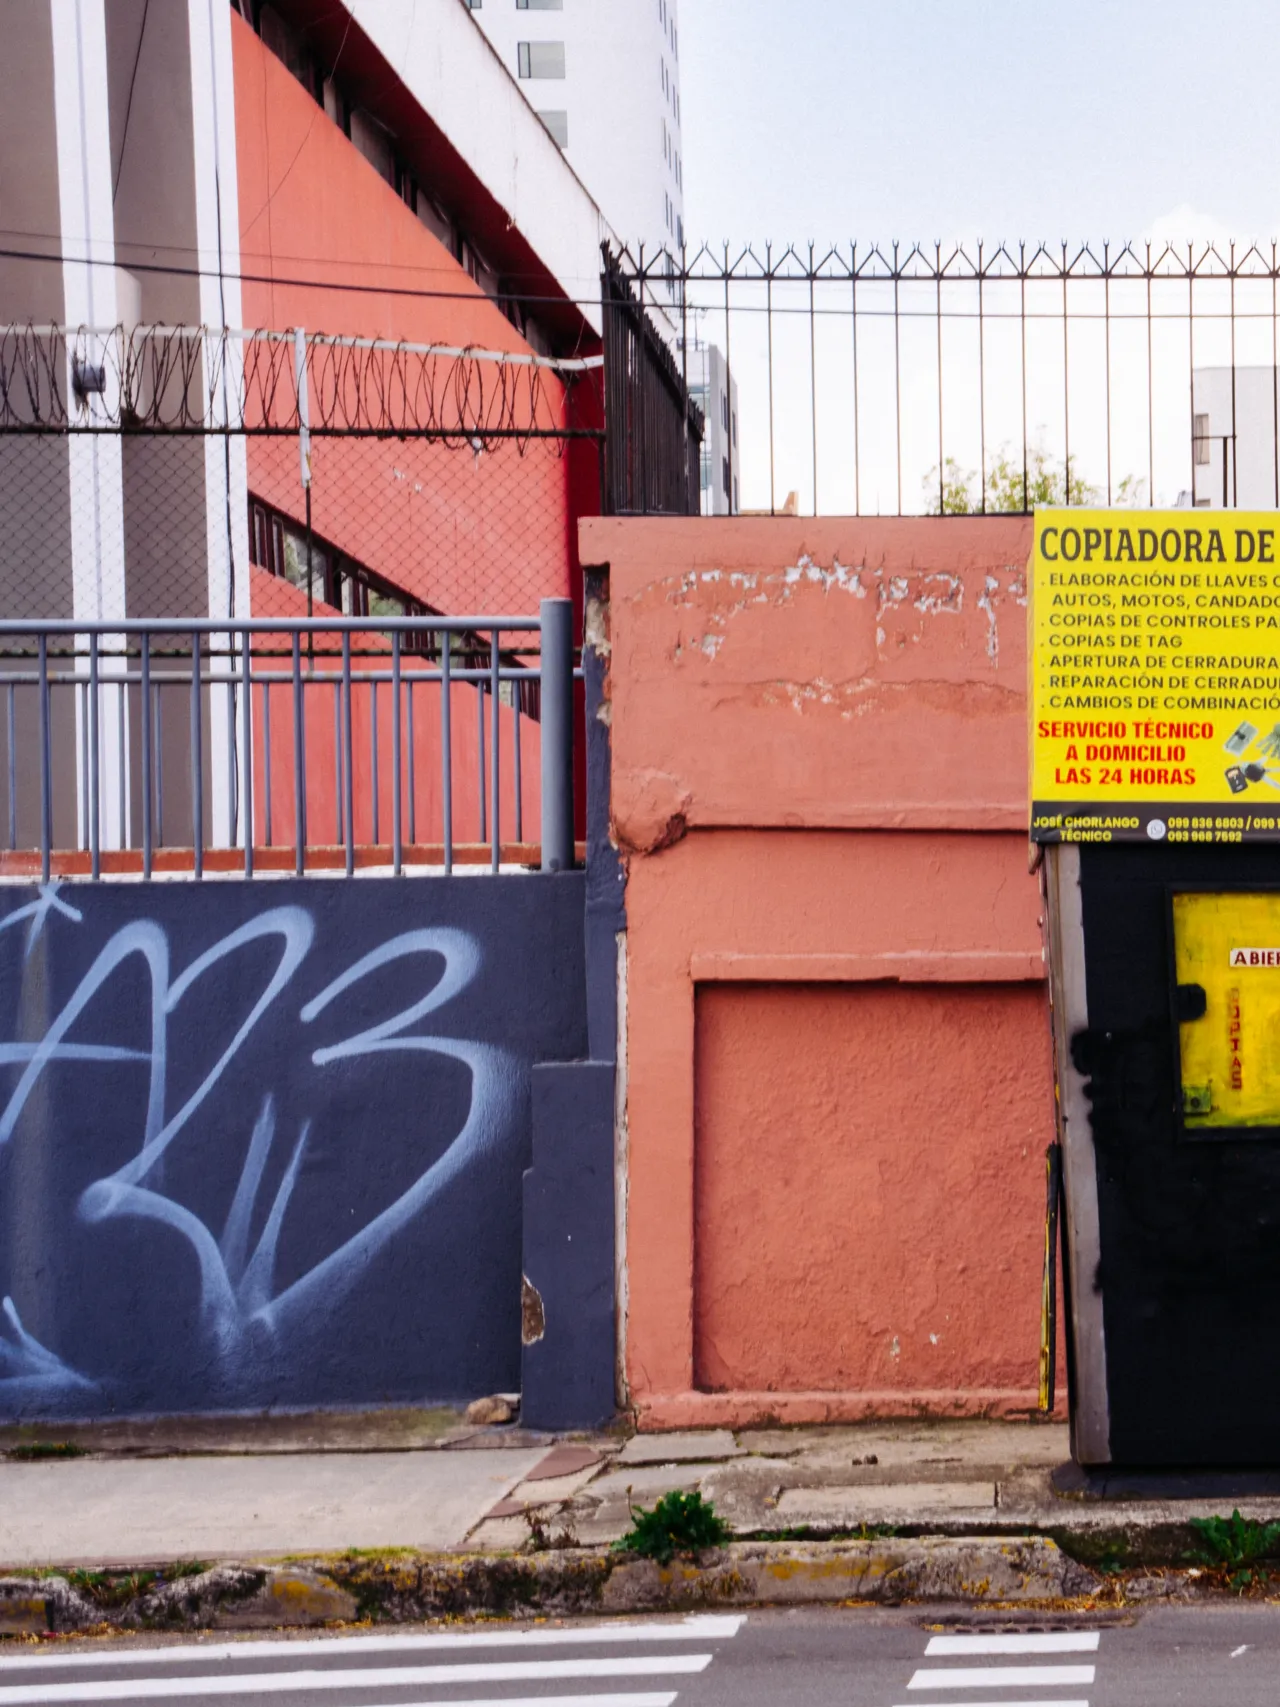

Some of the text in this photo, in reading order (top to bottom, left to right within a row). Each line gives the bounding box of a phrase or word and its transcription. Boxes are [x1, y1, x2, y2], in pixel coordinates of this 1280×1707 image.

[1040, 527, 1227, 563] COPIADORA
[1234, 529, 1275, 563] DE
[1049, 570, 1175, 588] ELABORACIÓN
[1180, 574, 1201, 587] DE
[1206, 575, 1268, 588] LLAVES
[1052, 593, 1117, 609] AUTOS,
[1121, 594, 1190, 610] MOTOS,
[1049, 613, 1116, 627] COPIAS
[1121, 614, 1142, 627] DE
[1146, 615, 1250, 628] CONTROLES
[1049, 634, 1183, 648] COPIAS DE TAG
[1049, 655, 1141, 668] APERTURA
[1146, 656, 1167, 668] DE
[1049, 671, 1164, 689] REPARACIÓN
[1169, 676, 1189, 689] DE
[1049, 695, 1133, 709] CAMBIOS
[1138, 697, 1159, 709] DE
[1038, 717, 1214, 739] SERVICIO TÉCNICO
[1065, 744, 1186, 762] A DOMICILIO
[1054, 767, 1196, 785] LAS 24 HORAS
[1033, 814, 1140, 829] JOSÉ CHORLANGO
[1167, 817, 1190, 829] 099
[1253, 817, 1275, 830] 099
[1059, 828, 1112, 842] TÉCNICO
